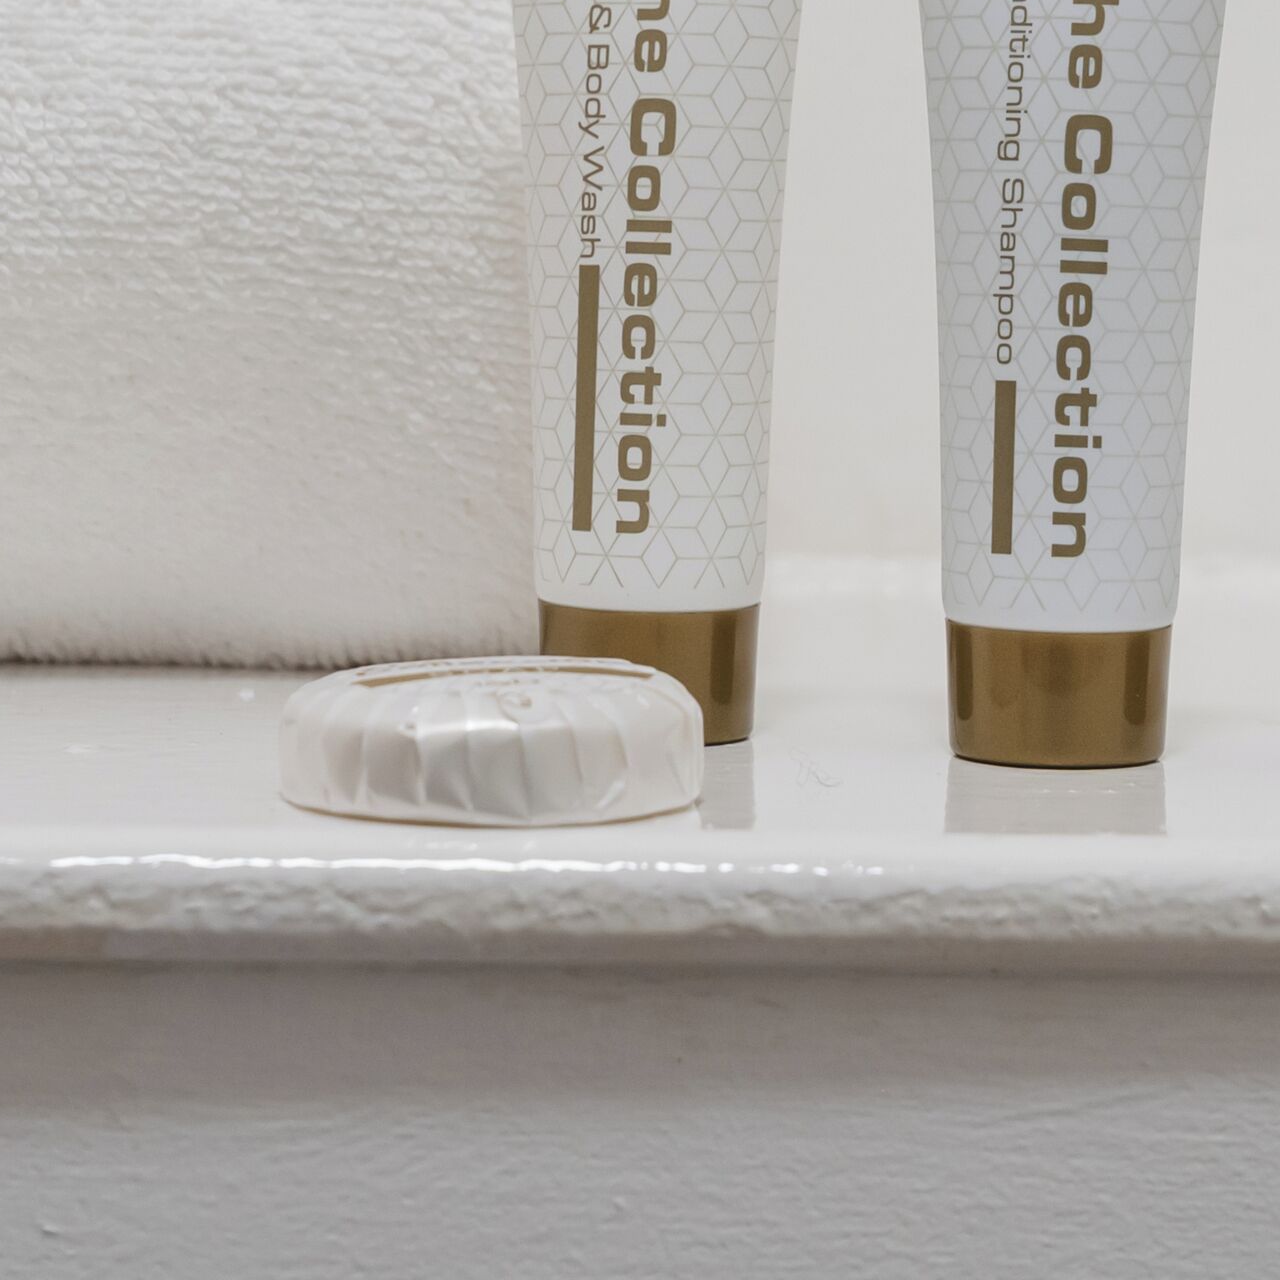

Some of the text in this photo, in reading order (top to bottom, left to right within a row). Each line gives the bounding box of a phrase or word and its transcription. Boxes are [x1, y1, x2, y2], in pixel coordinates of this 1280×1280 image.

[578, 43, 610, 140] Body
[588, 3, 612, 34] &
[578, 146, 604, 259] Wash
[992, 178, 1025, 366] Shampoo
[615, 97, 677, 534] Collection
[1050, 113, 1114, 559] Collection
